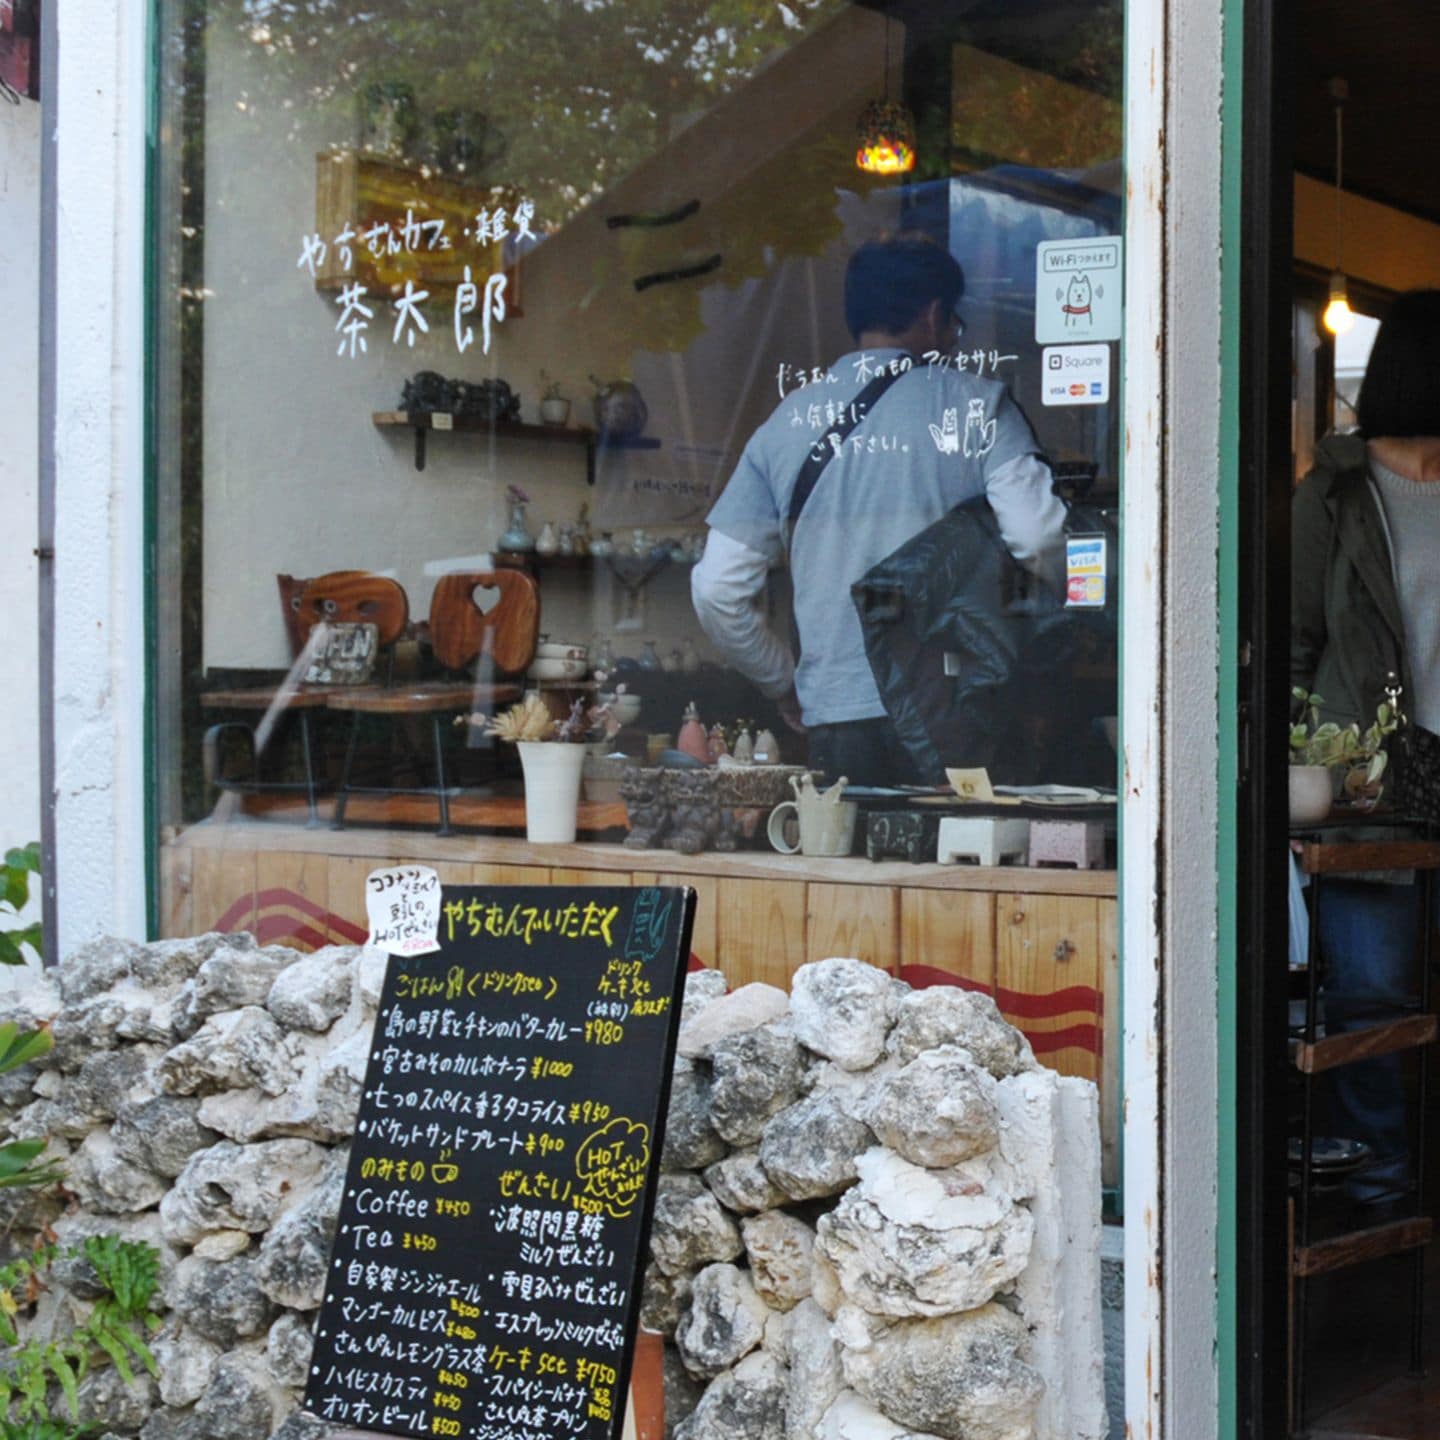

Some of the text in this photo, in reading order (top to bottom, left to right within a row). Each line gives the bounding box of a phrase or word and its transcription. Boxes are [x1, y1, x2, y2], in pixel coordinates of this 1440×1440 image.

[334, 265, 509, 360] 茶太郎
[1064, 355, 1103, 369] Square
[442, 897, 620, 947] やちむんでいただく
[384, 1002, 625, 1046] 島の野菜とチキンのバターカレー ¥980
[381, 1045, 574, 1081] 宮古みそのカルボナーラ ¥1000
[373, 1082, 567, 1126] 七つのスパイス香るタコライス
[524, 1132, 566, 1157] ¥900
[587, 1140, 625, 1169] HOT
[360, 1157, 426, 1182] のみもの
[498, 1169, 573, 1201] ぜんざい
[355, 1187, 472, 1218] Coffee ¥450
[352, 1224, 395, 1251] Tea
[519, 1241, 615, 1268] ミルクぜんざい
[341, 1296, 449, 1333] マンゴーカルピス
[575, 1357, 618, 1389] ¥750
[321, 1394, 429, 1431] オリオンビール
